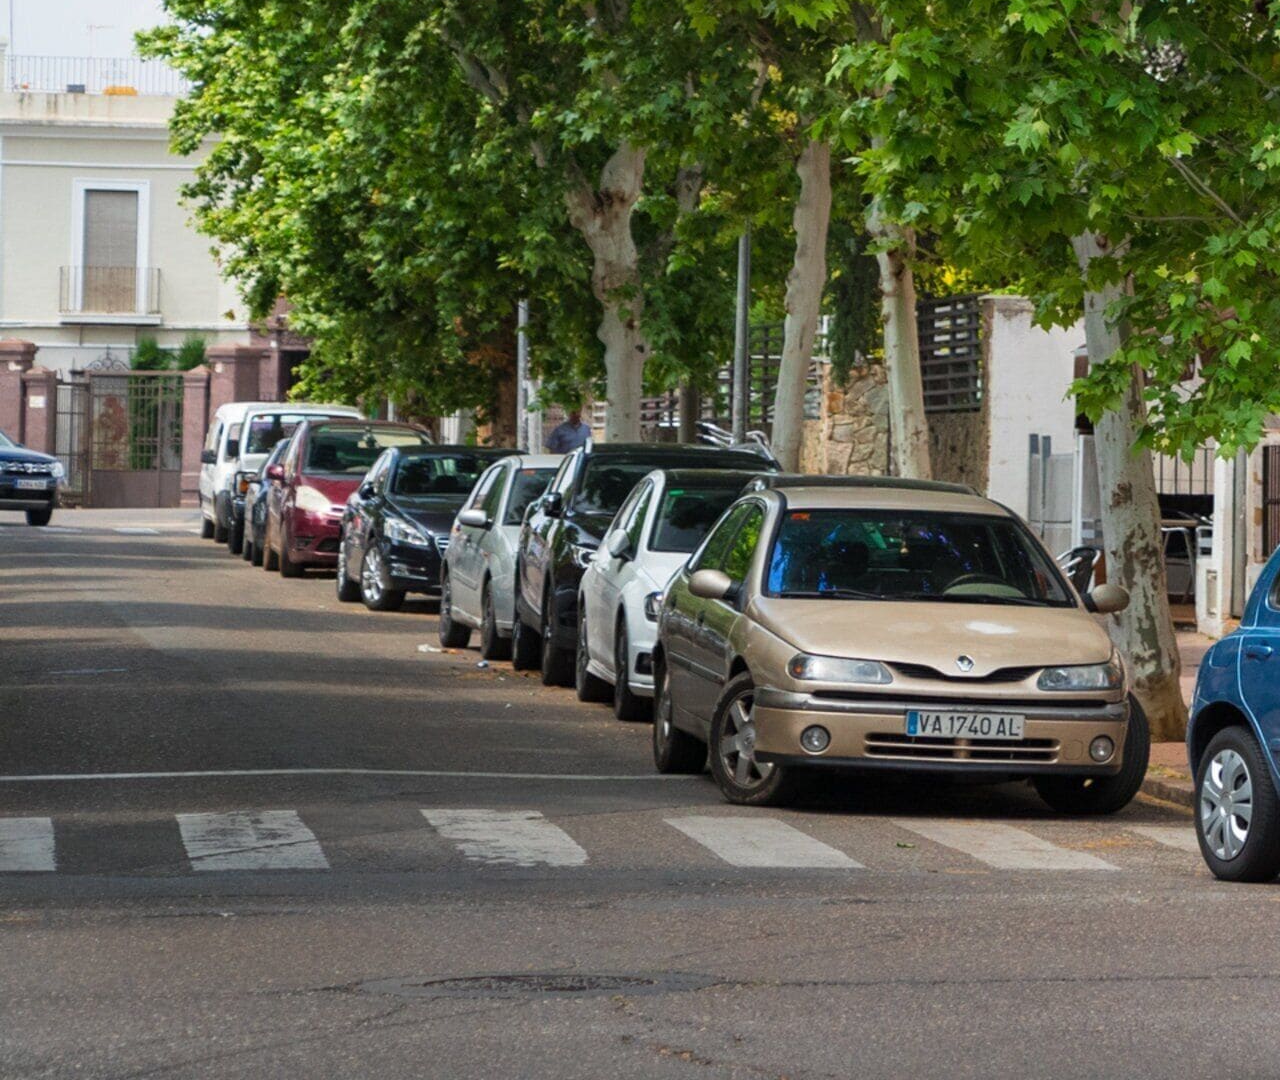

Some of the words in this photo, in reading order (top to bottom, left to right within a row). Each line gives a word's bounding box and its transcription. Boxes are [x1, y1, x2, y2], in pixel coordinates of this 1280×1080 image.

[920, 714, 942, 734] VA
[949, 715, 992, 736] 1740
[996, 717, 1020, 737] AL
